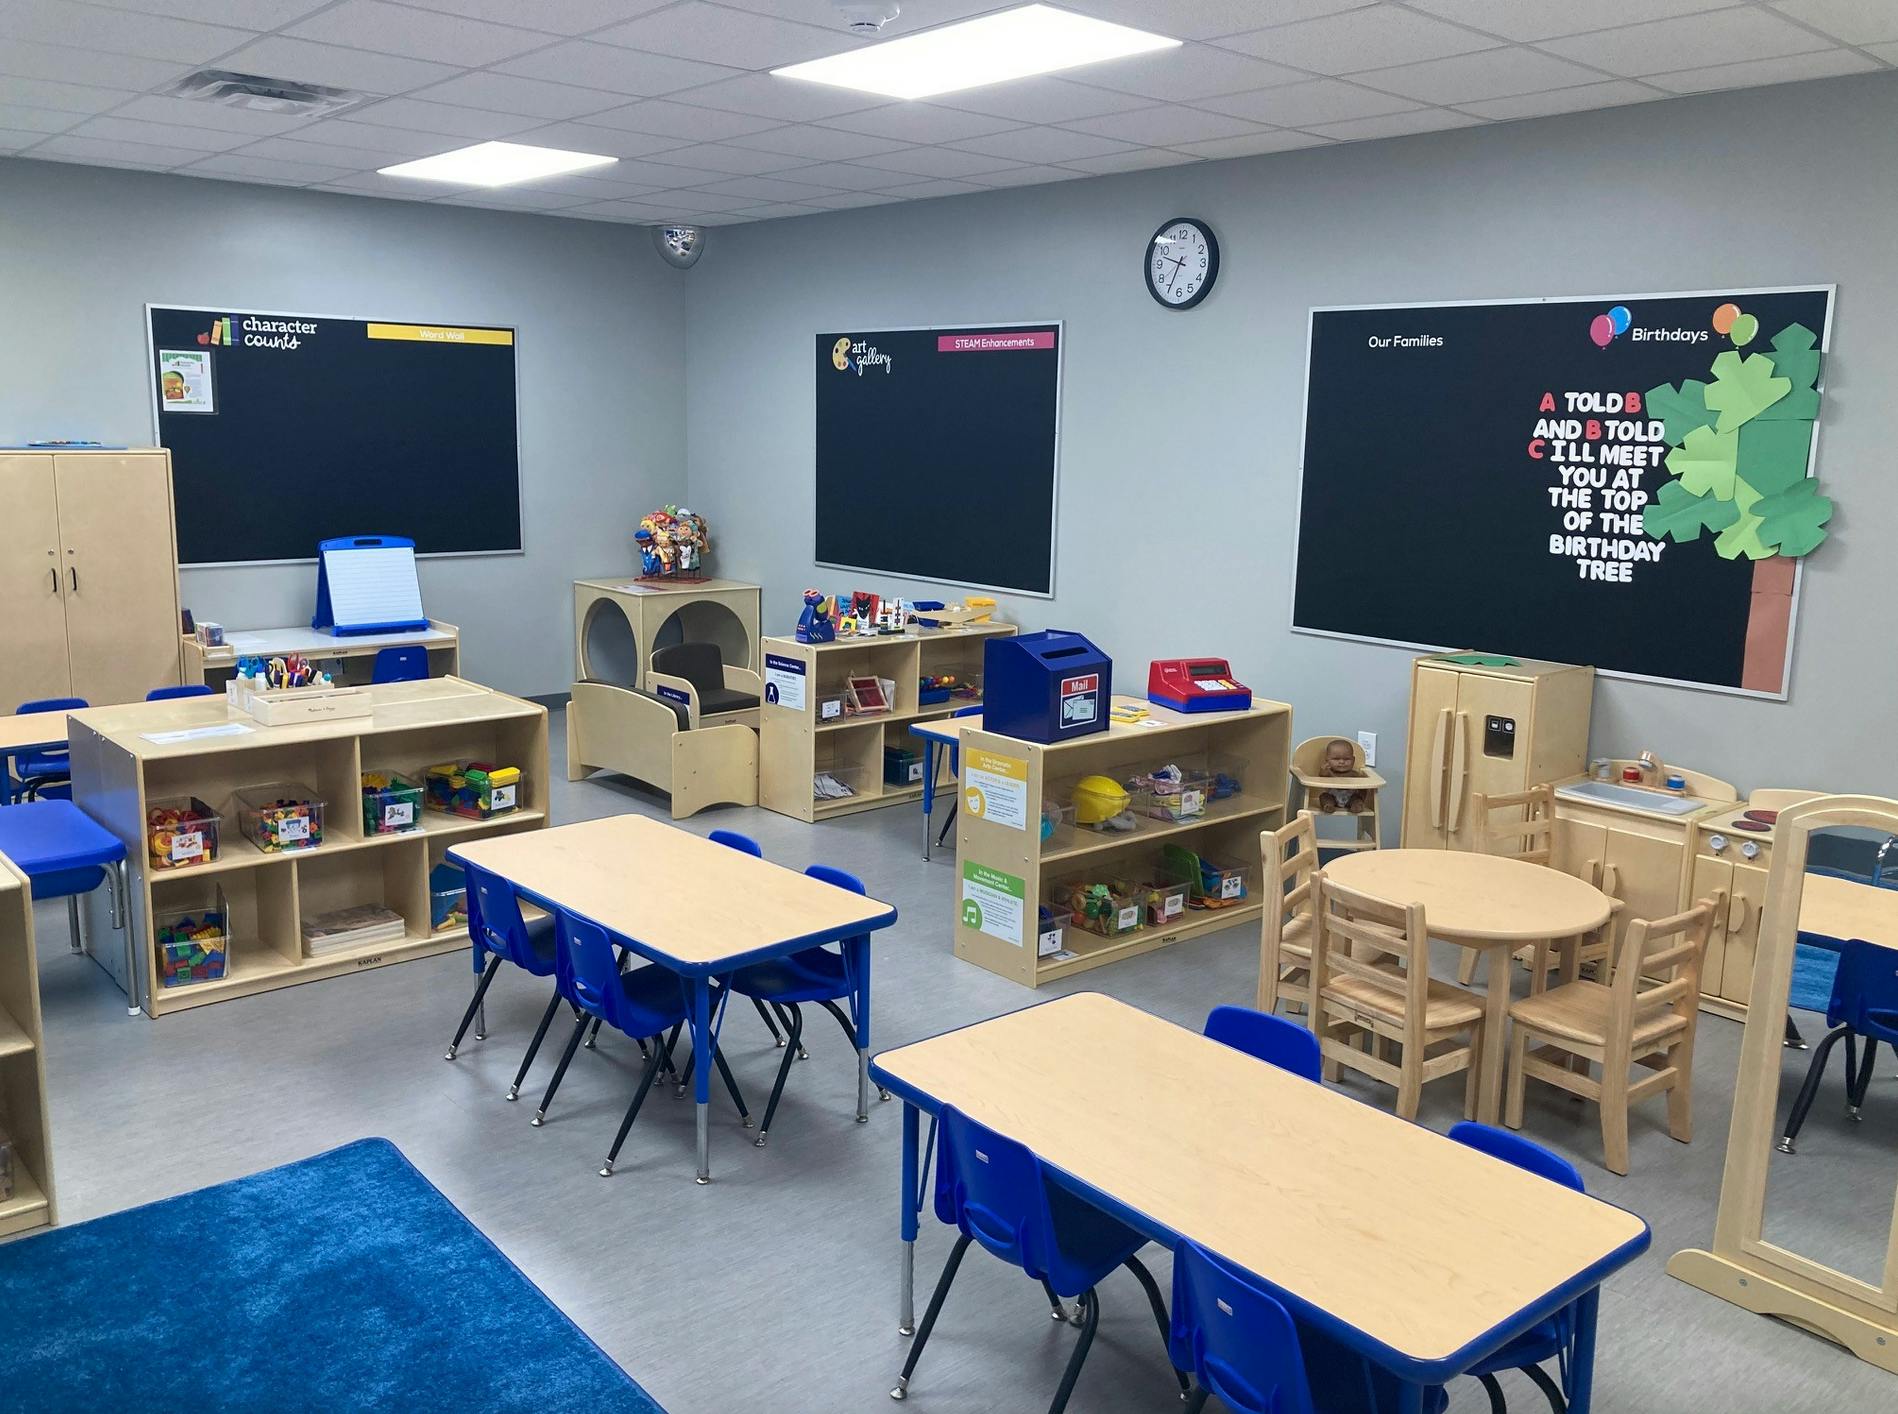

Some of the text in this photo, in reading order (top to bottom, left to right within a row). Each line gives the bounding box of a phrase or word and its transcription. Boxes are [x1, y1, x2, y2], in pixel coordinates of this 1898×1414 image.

[1179, 229, 1188, 240] 12
[1160, 245, 1170, 256] 10
[1198, 244, 1205, 255] 2
[1156, 259, 1163, 270] 9
[1199, 258, 1207, 268] 3
[1158, 273, 1165, 284] 8
[1195, 272, 1202, 283] 4
[1175, 287, 1183, 298] 6
[1186, 283, 1194, 294] 5
[242, 316, 318, 334] character
[419, 328, 444, 338] Word
[1632, 327, 1709, 345] Birthdays
[244, 332, 302, 350] counts
[852, 340, 867, 354] art
[955, 338, 1035, 349] STEAM Enhancements
[1368, 334, 1444, 348] Our Families
[856, 346, 892, 376] gallery
[1539, 391, 1642, 414] A TOLD B
[1532, 418, 1666, 443] AND B TOLD
[1527, 439, 1665, 468] C ILL MEET
[1558, 464, 1644, 490] YOU AT
[1547, 487, 1649, 512] THE TOP
[1563, 510, 1645, 536] OF THE
[1549, 533, 1667, 563] BIRTHDAY
[1576, 558, 1634, 583] TREE
[1071, 679, 1089, 692] Mail
[358, 957, 382, 966] KAPLAN
